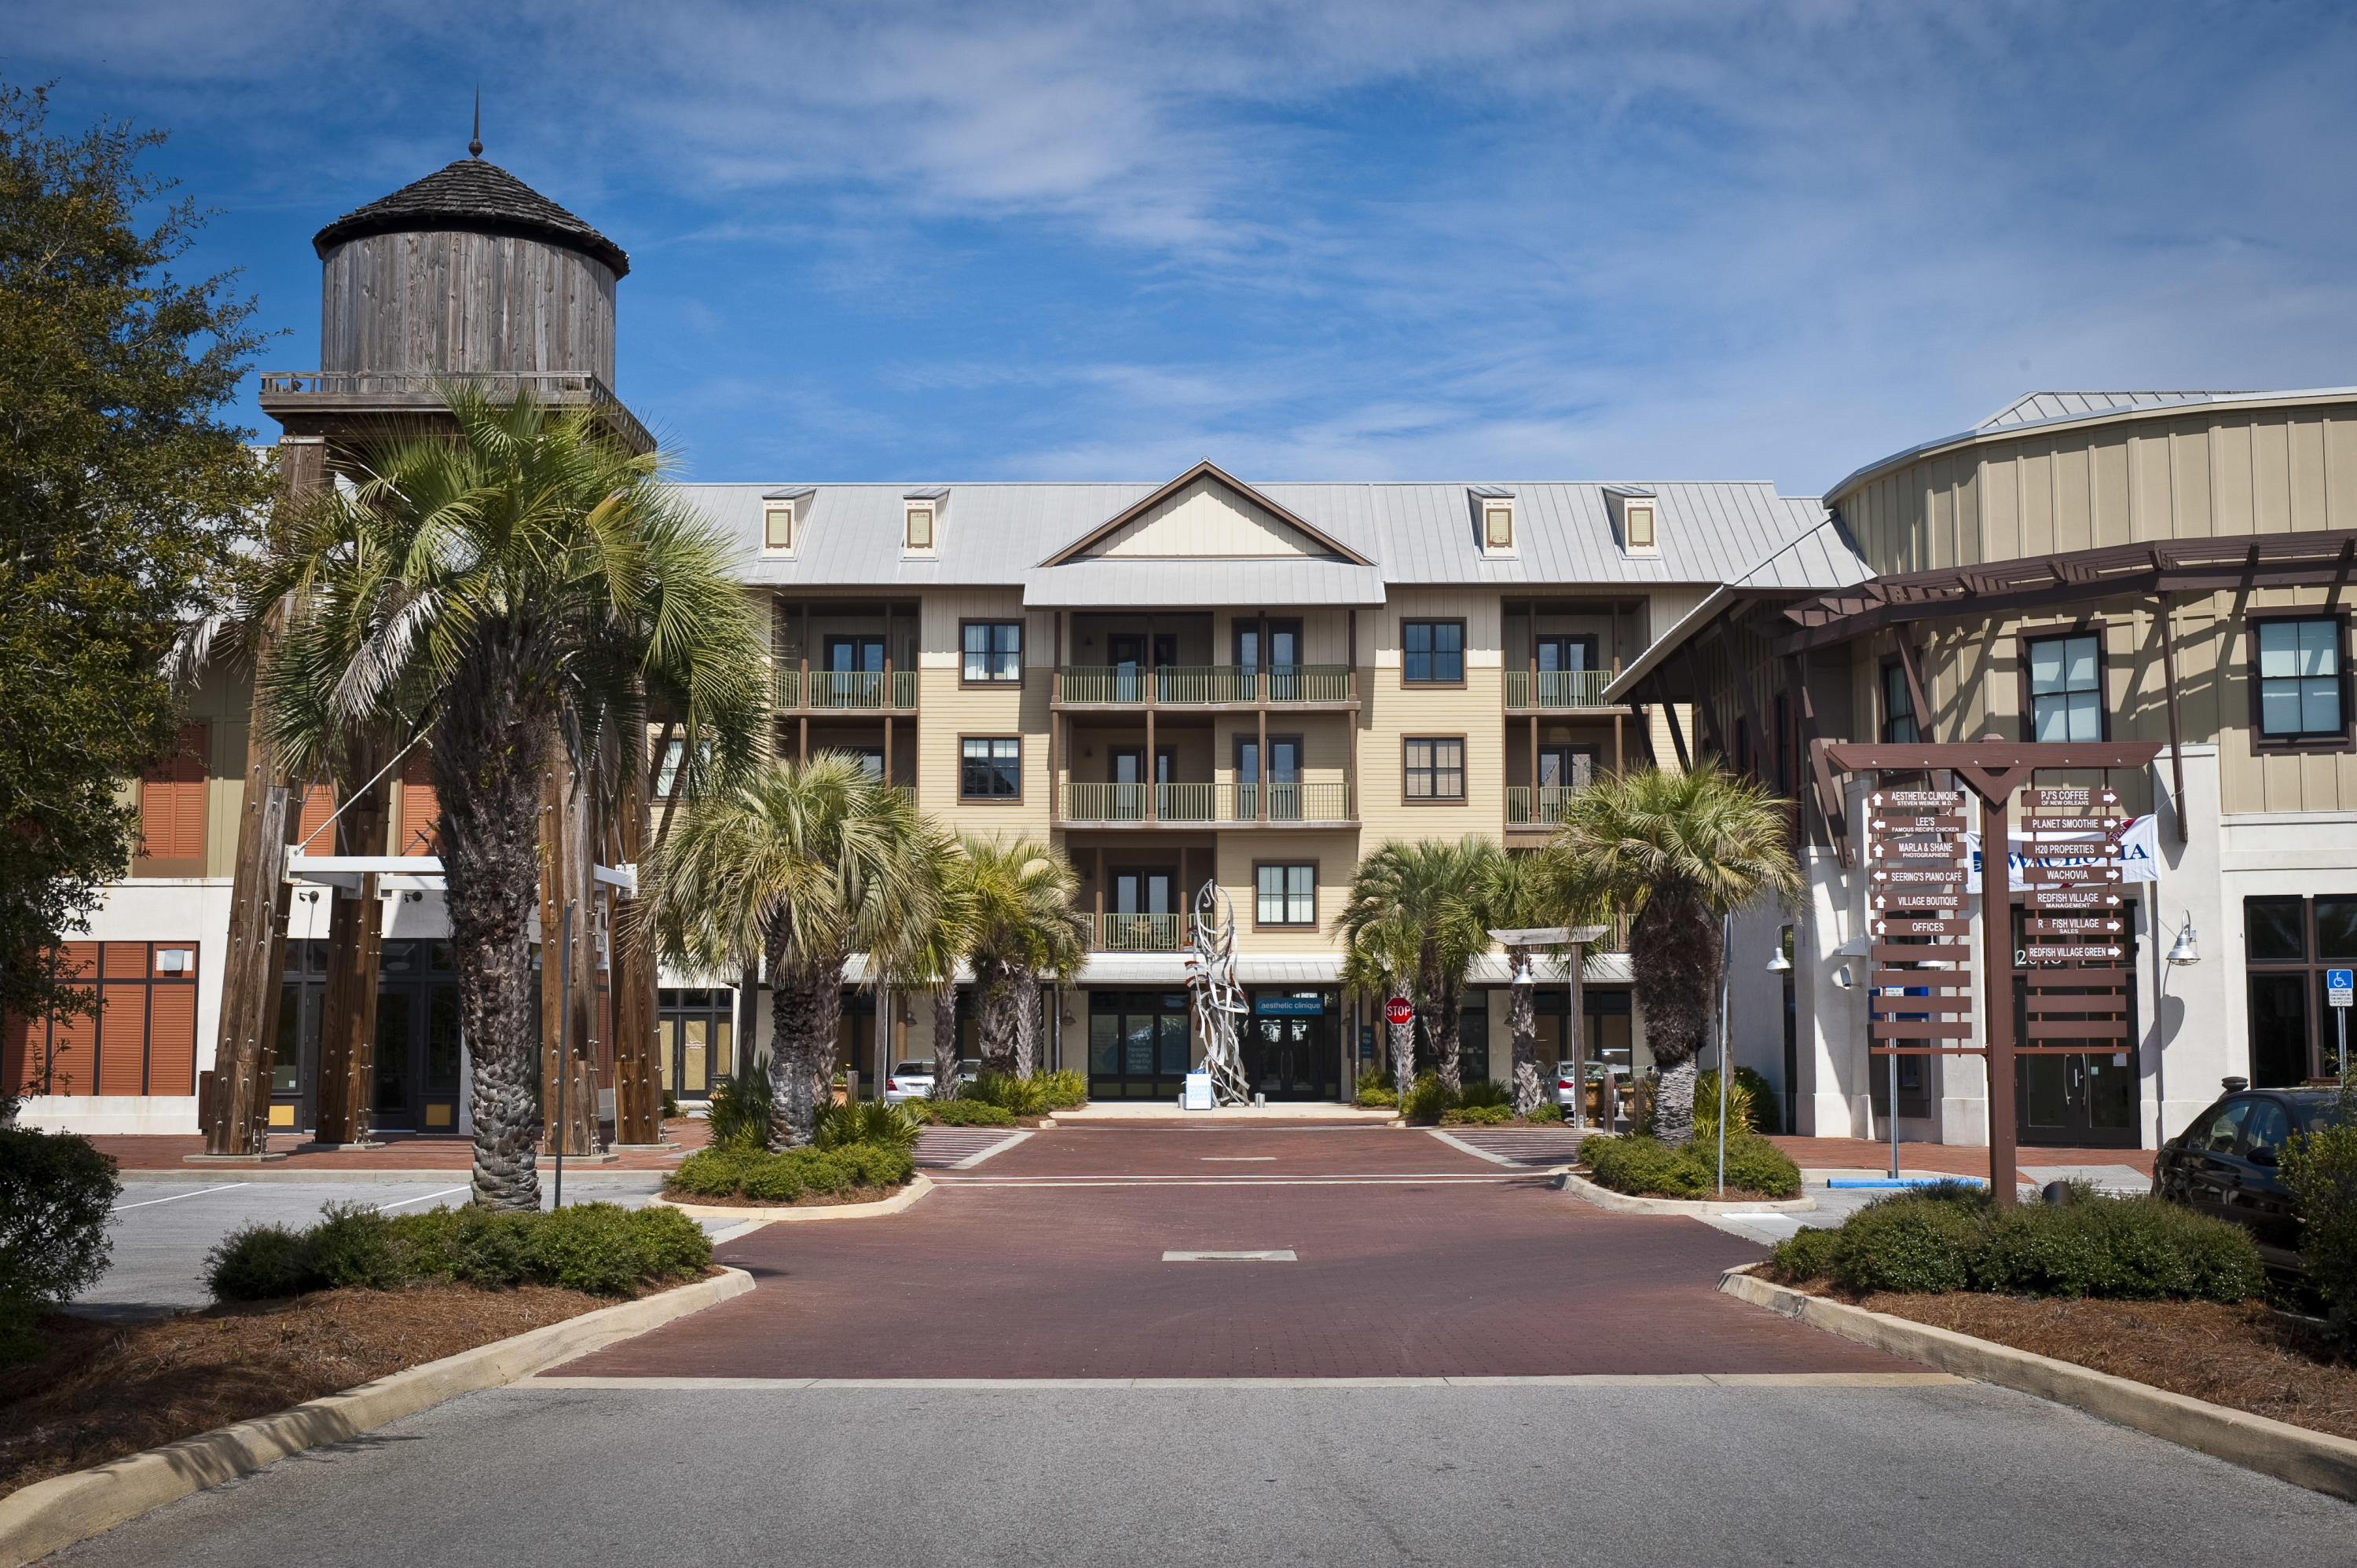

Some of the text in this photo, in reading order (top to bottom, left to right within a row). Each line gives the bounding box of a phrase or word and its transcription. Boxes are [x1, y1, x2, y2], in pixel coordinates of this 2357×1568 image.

[1891, 791, 1959, 800] AESTHETIC CLINIQUE
[2040, 791, 2089, 800] PJ'S COFFEE
[1915, 817, 1935, 826] LEE'S
[2033, 819, 2099, 828] PLANET SMOOTHIE
[1898, 843, 1953, 852] MARLA & SHANE
[2050, 845, 2095, 854] PROPERTIES
[1891, 870, 1962, 881] SEERING'S PIANO CAFÉ
[2047, 870, 2088, 880] WACHOVIA
[1897, 896, 1958, 906] VILLAGE BOUTIQUE
[2037, 893, 2099, 903] REDFISH VILLAGE
[1912, 922, 1944, 932] OFFICES
[2069, 919, 2099, 928] VILLAGE
[2029, 947, 2106, 957] REDFISH VILLAGE GREEN
[1387, 1006, 1411, 1017] STOP
